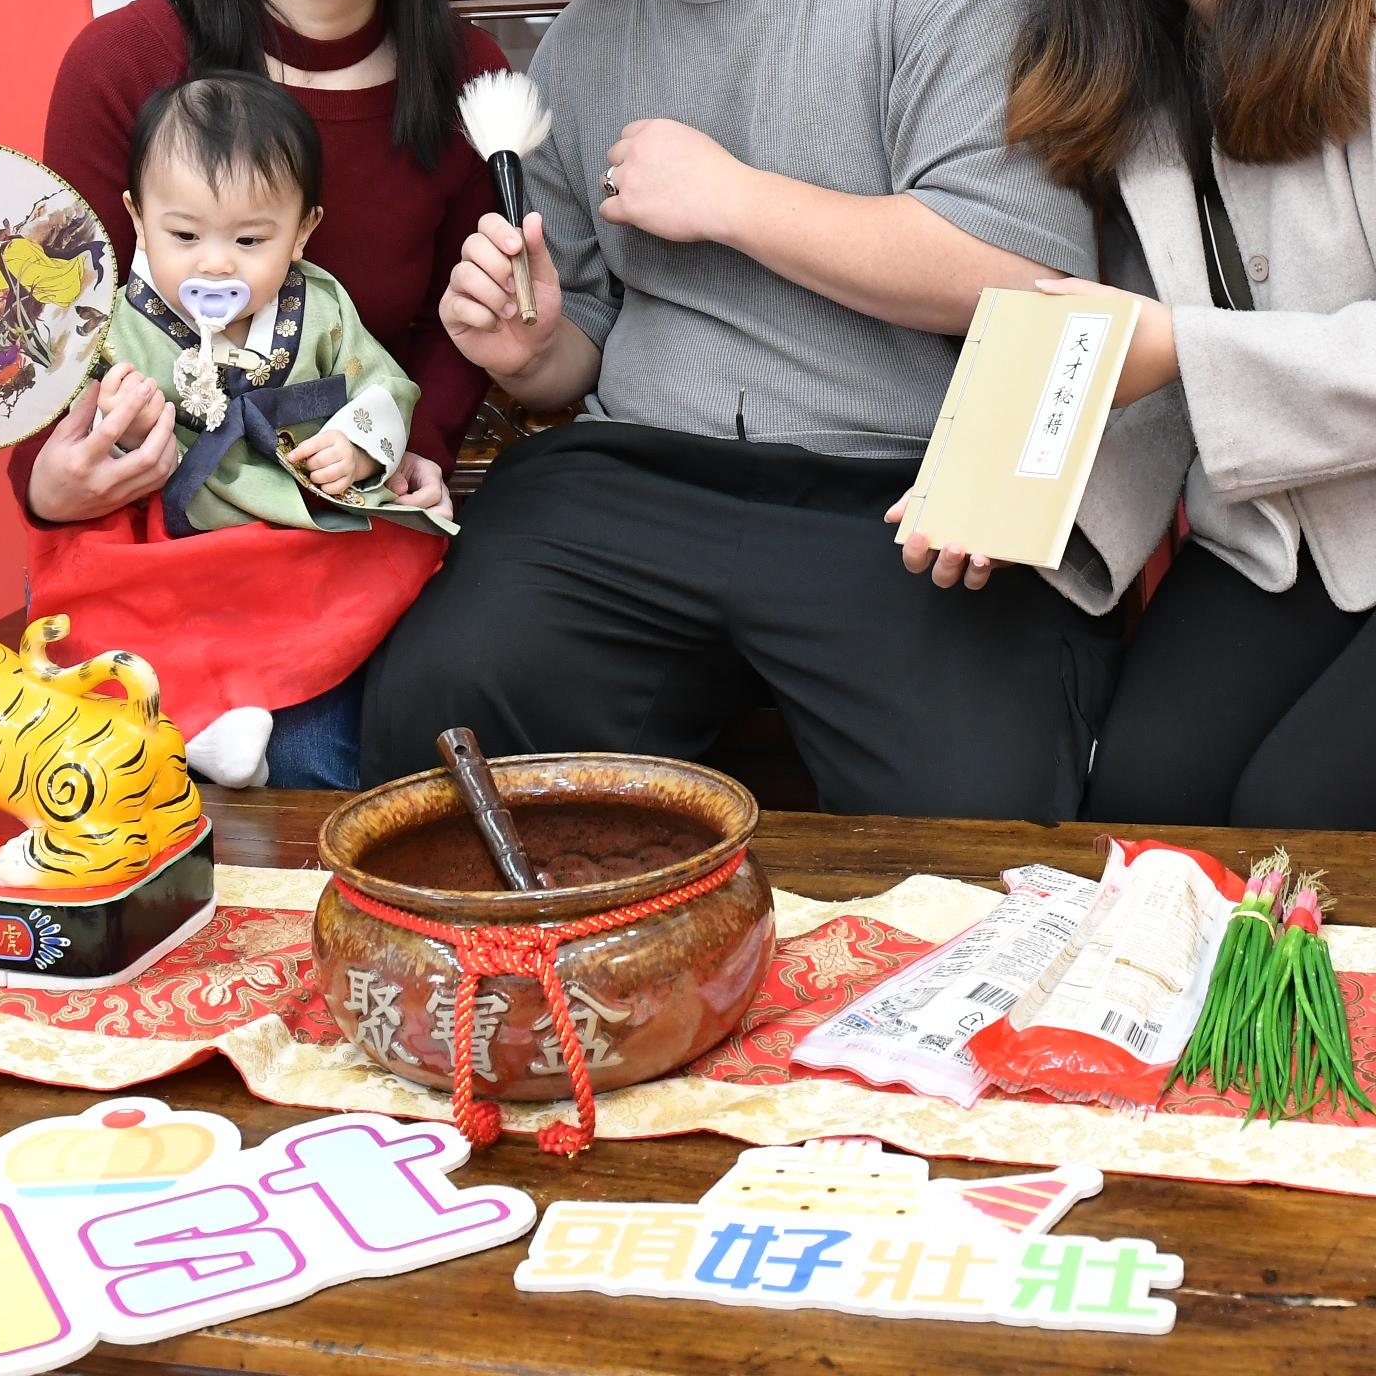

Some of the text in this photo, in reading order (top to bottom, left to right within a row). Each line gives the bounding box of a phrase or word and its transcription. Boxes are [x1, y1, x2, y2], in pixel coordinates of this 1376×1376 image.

[343, 968, 632, 1084] 聚寶盆
[529, 1208, 1178, 1316] 頭好壯壯
